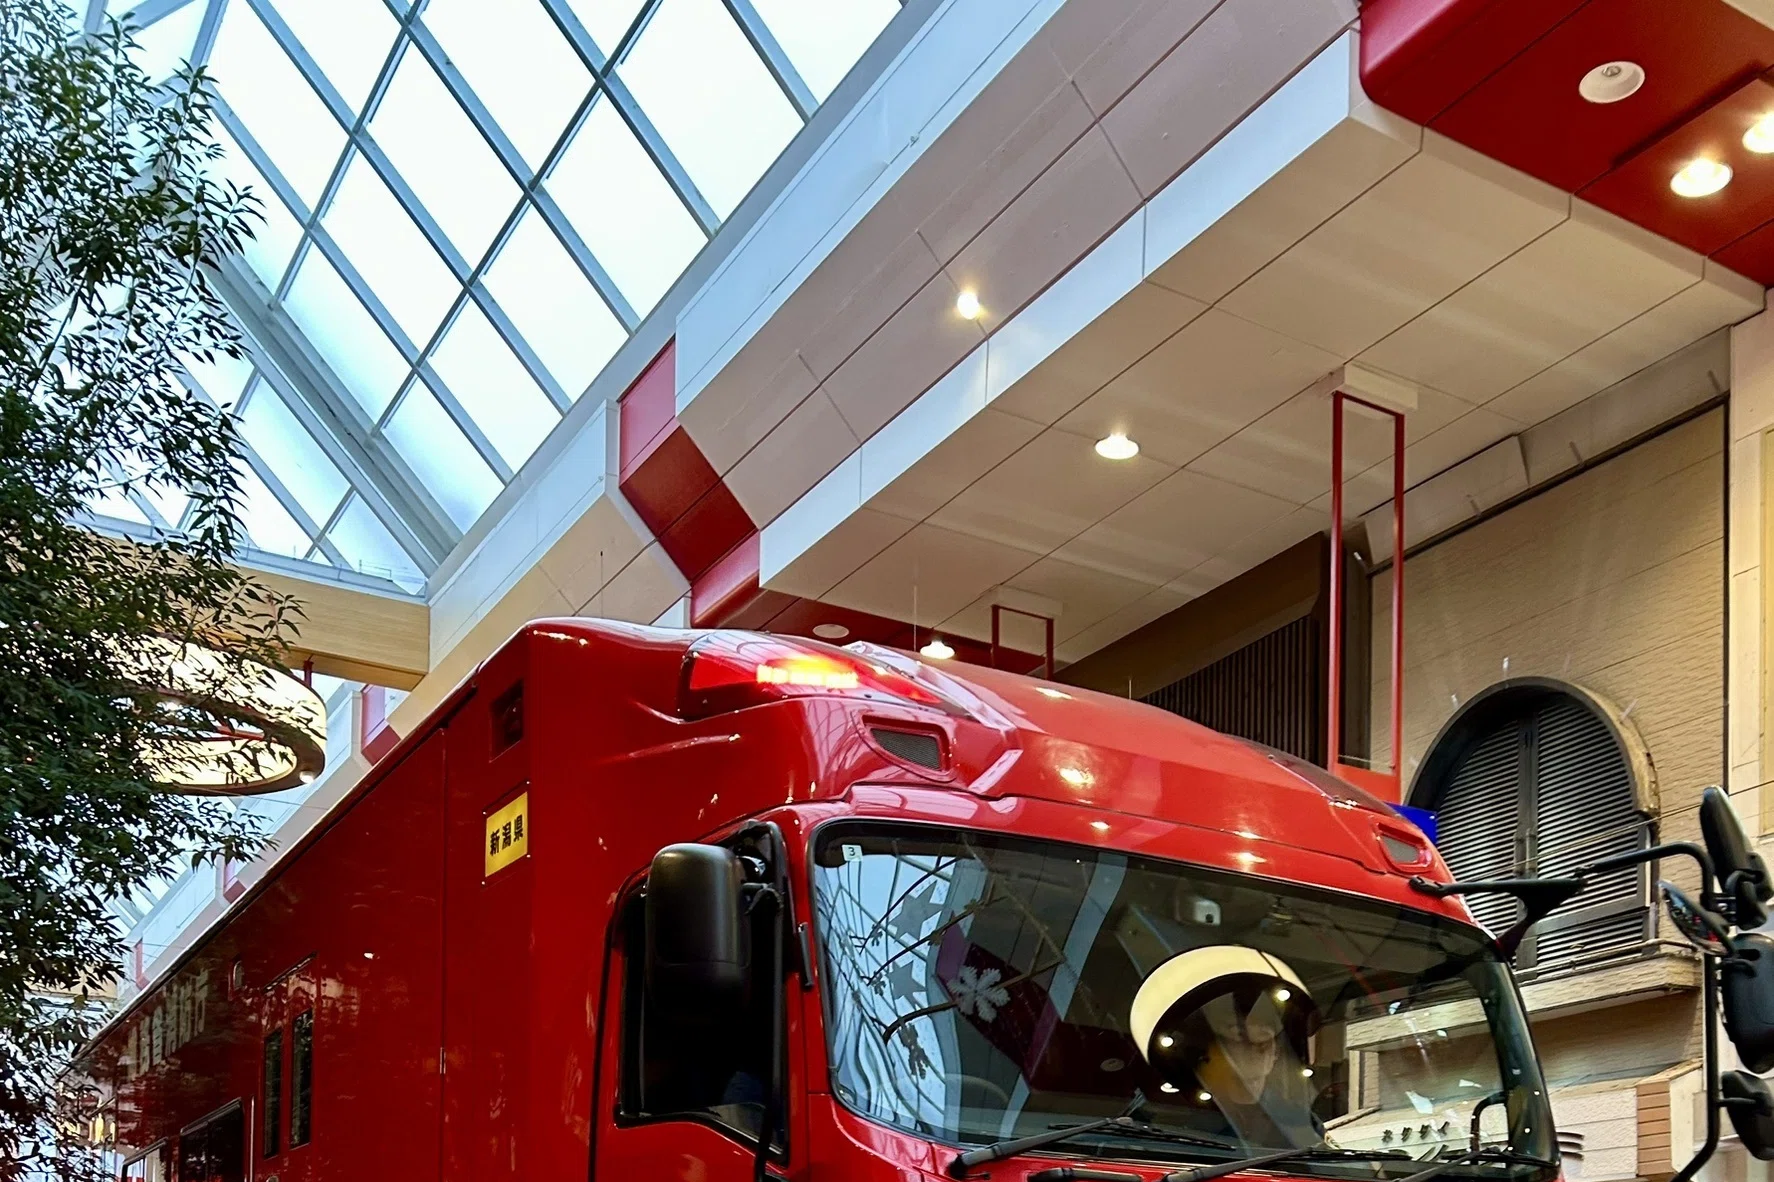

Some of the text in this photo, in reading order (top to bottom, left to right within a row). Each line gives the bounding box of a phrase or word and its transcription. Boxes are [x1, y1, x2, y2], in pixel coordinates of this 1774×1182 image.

[489, 814, 523, 856] 新潟県
[848, 846, 856, 856] 3
